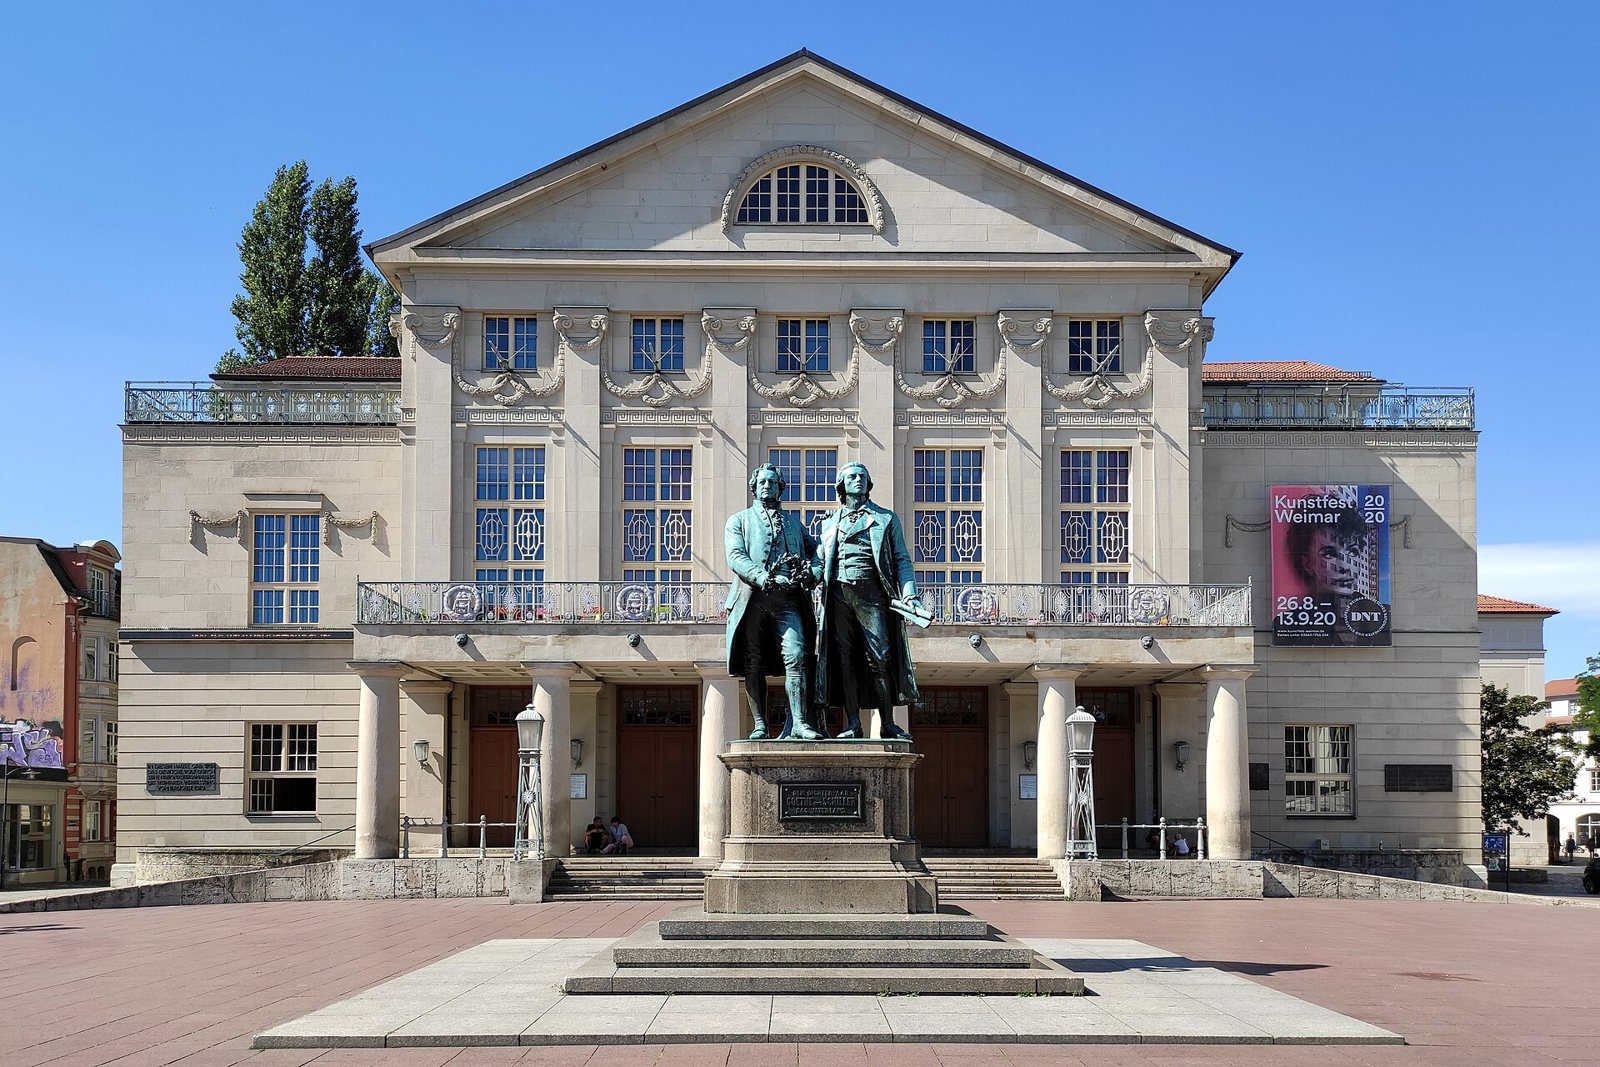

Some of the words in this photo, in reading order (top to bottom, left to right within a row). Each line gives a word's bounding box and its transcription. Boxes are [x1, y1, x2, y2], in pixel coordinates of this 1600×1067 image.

[1275, 495, 1353, 509] Kunstfest
[1364, 495, 1385, 507] 20
[1275, 509, 1340, 523] Weimar
[1364, 511, 1385, 523] 20
[1277, 611, 1336, 626] 13.9.20
[1350, 611, 1381, 622] DNT
[787, 797, 814, 806] GOETHE
